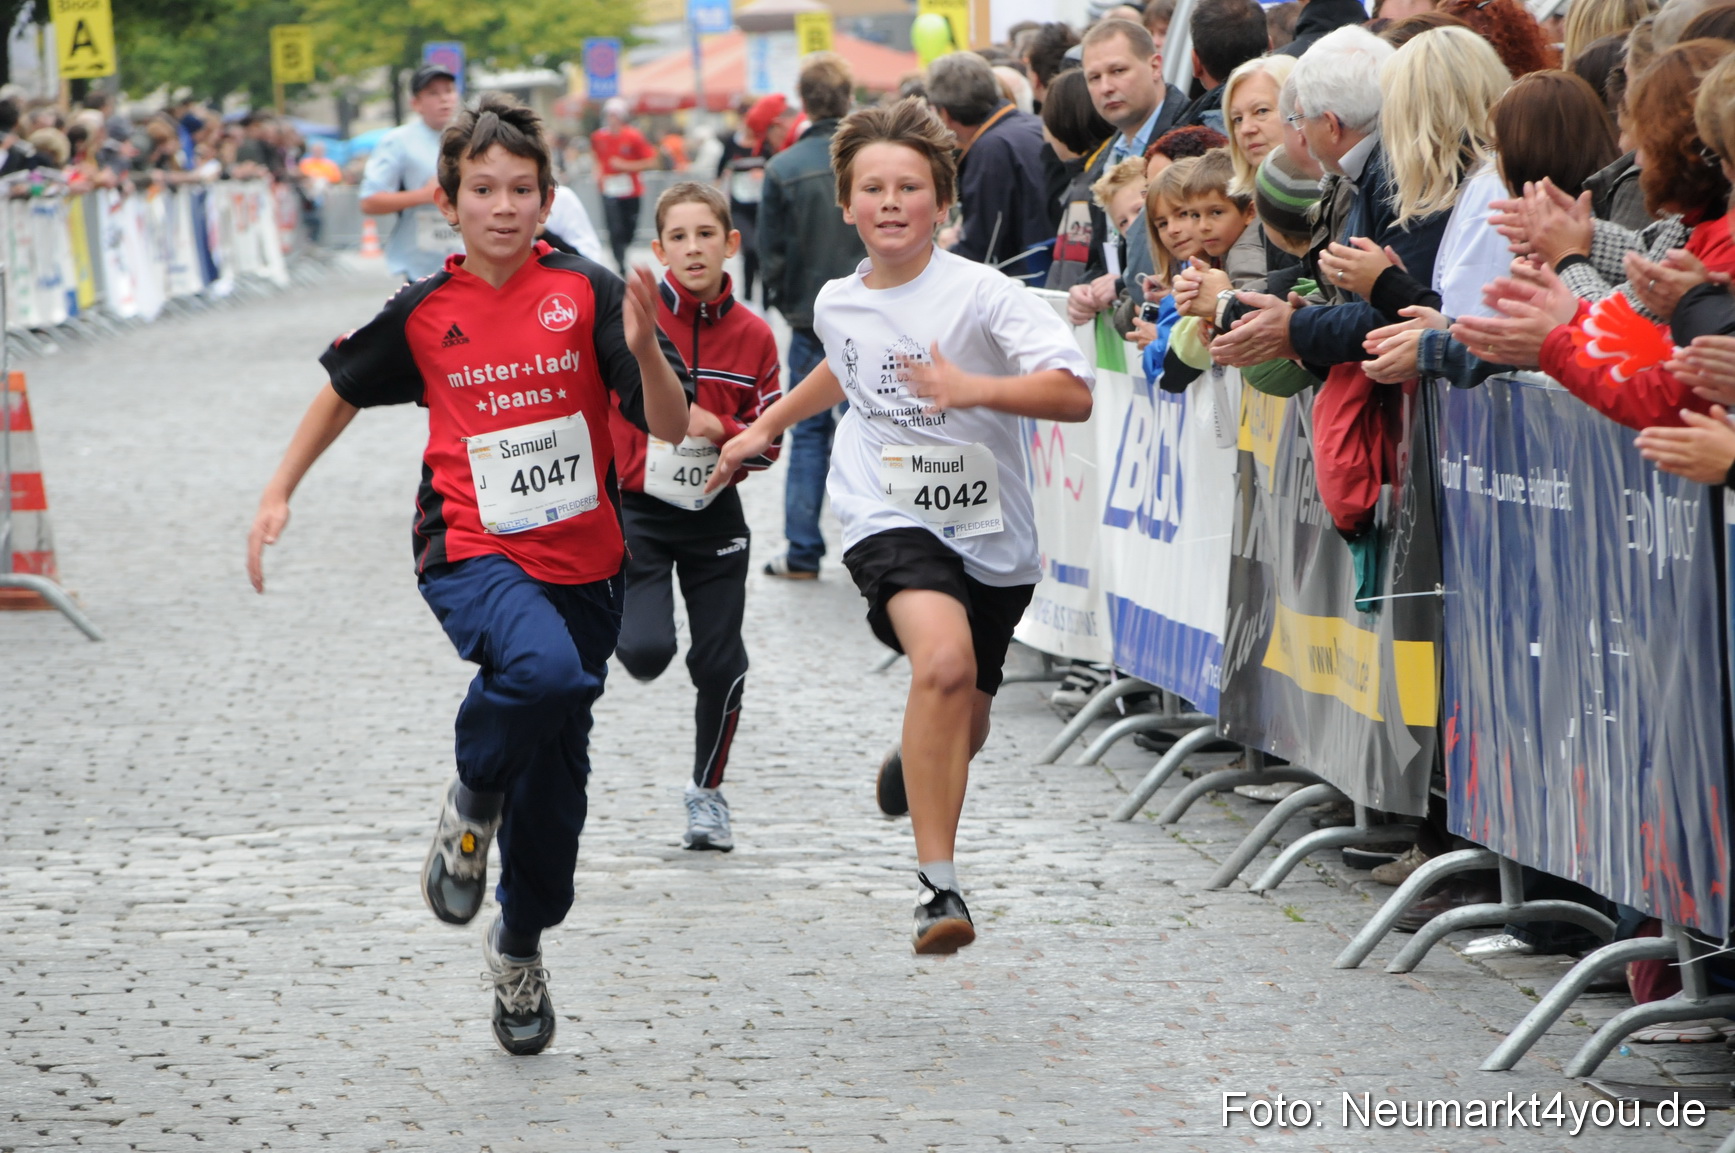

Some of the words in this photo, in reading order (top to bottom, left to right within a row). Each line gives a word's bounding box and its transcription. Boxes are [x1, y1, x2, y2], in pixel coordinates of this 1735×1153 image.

[69, 18, 100, 57] A
[543, 308, 575, 325] FCN
[441, 336, 470, 348] adidas
[488, 388, 553, 416] jeans
[500, 430, 558, 459] Samuel
[912, 455, 964, 473] Manuel
[480, 475, 487, 490] J
[510, 454, 580, 496] 4047
[886, 483, 892, 495] J
[914, 480, 988, 511] 4042
[558, 494, 597, 514] PFLEIDERER
[956, 519, 1001, 532] PFLEIDERER
